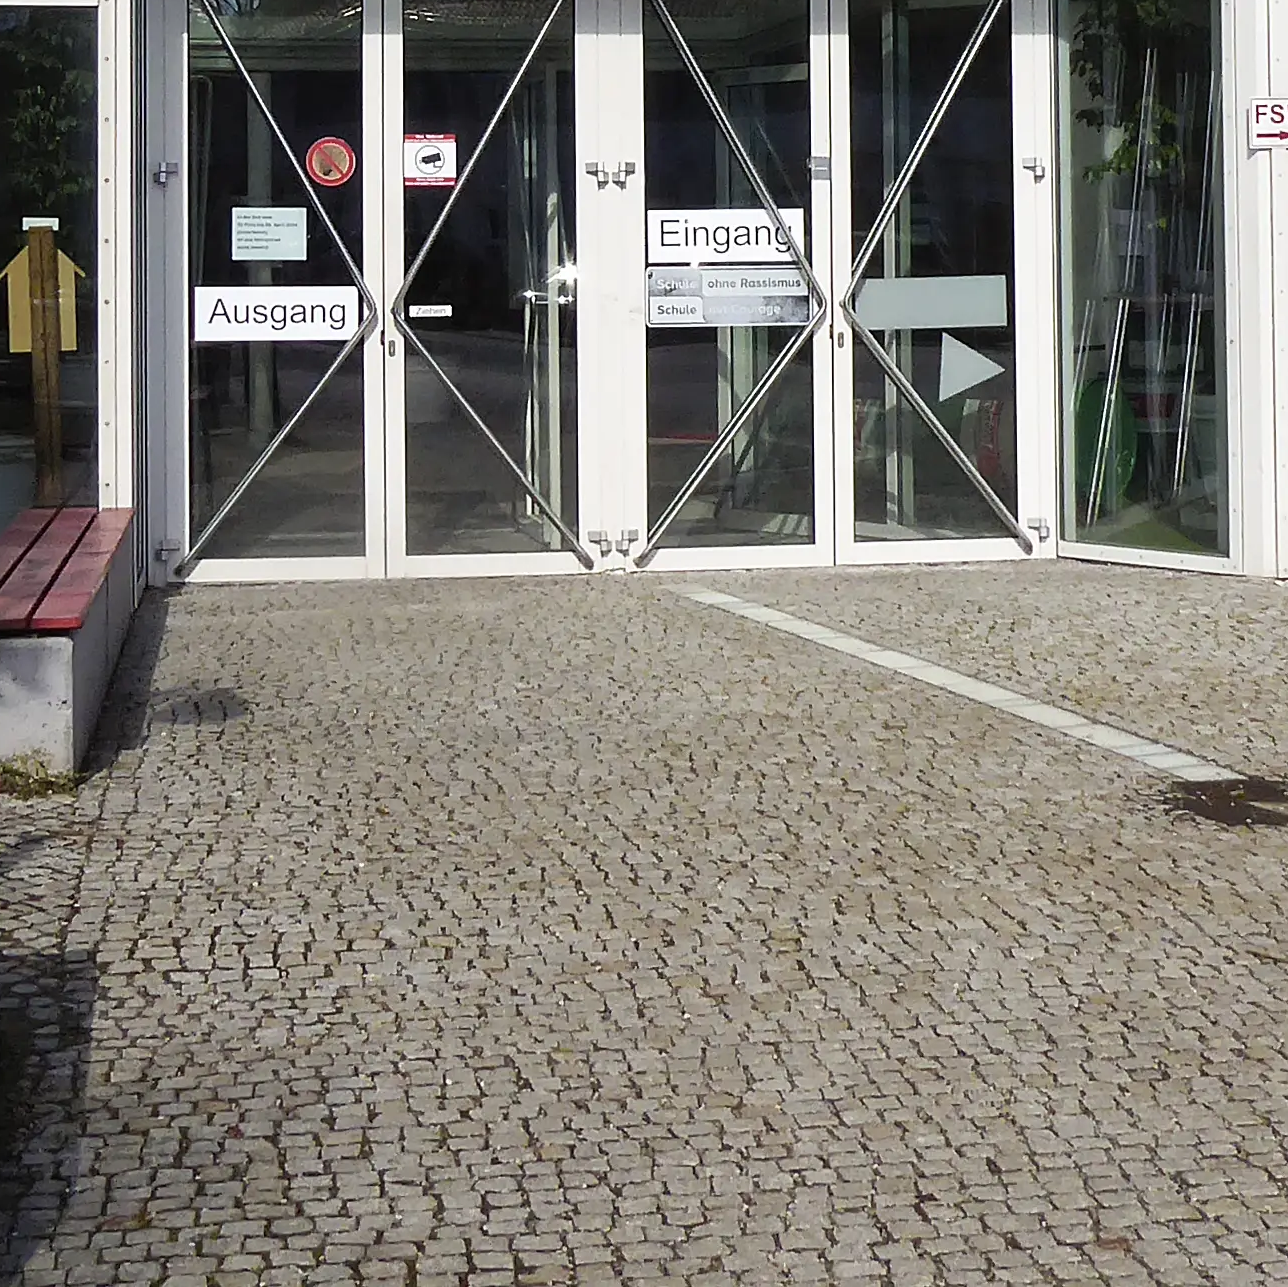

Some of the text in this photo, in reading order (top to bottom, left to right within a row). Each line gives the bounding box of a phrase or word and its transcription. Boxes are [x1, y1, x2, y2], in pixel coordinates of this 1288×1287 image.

[659, 219, 793, 253] Eingang
[656, 277, 801, 291] Schule ohne Rassismus
[208, 299, 346, 330] Ausgang
[657, 305, 697, 316] Schule
